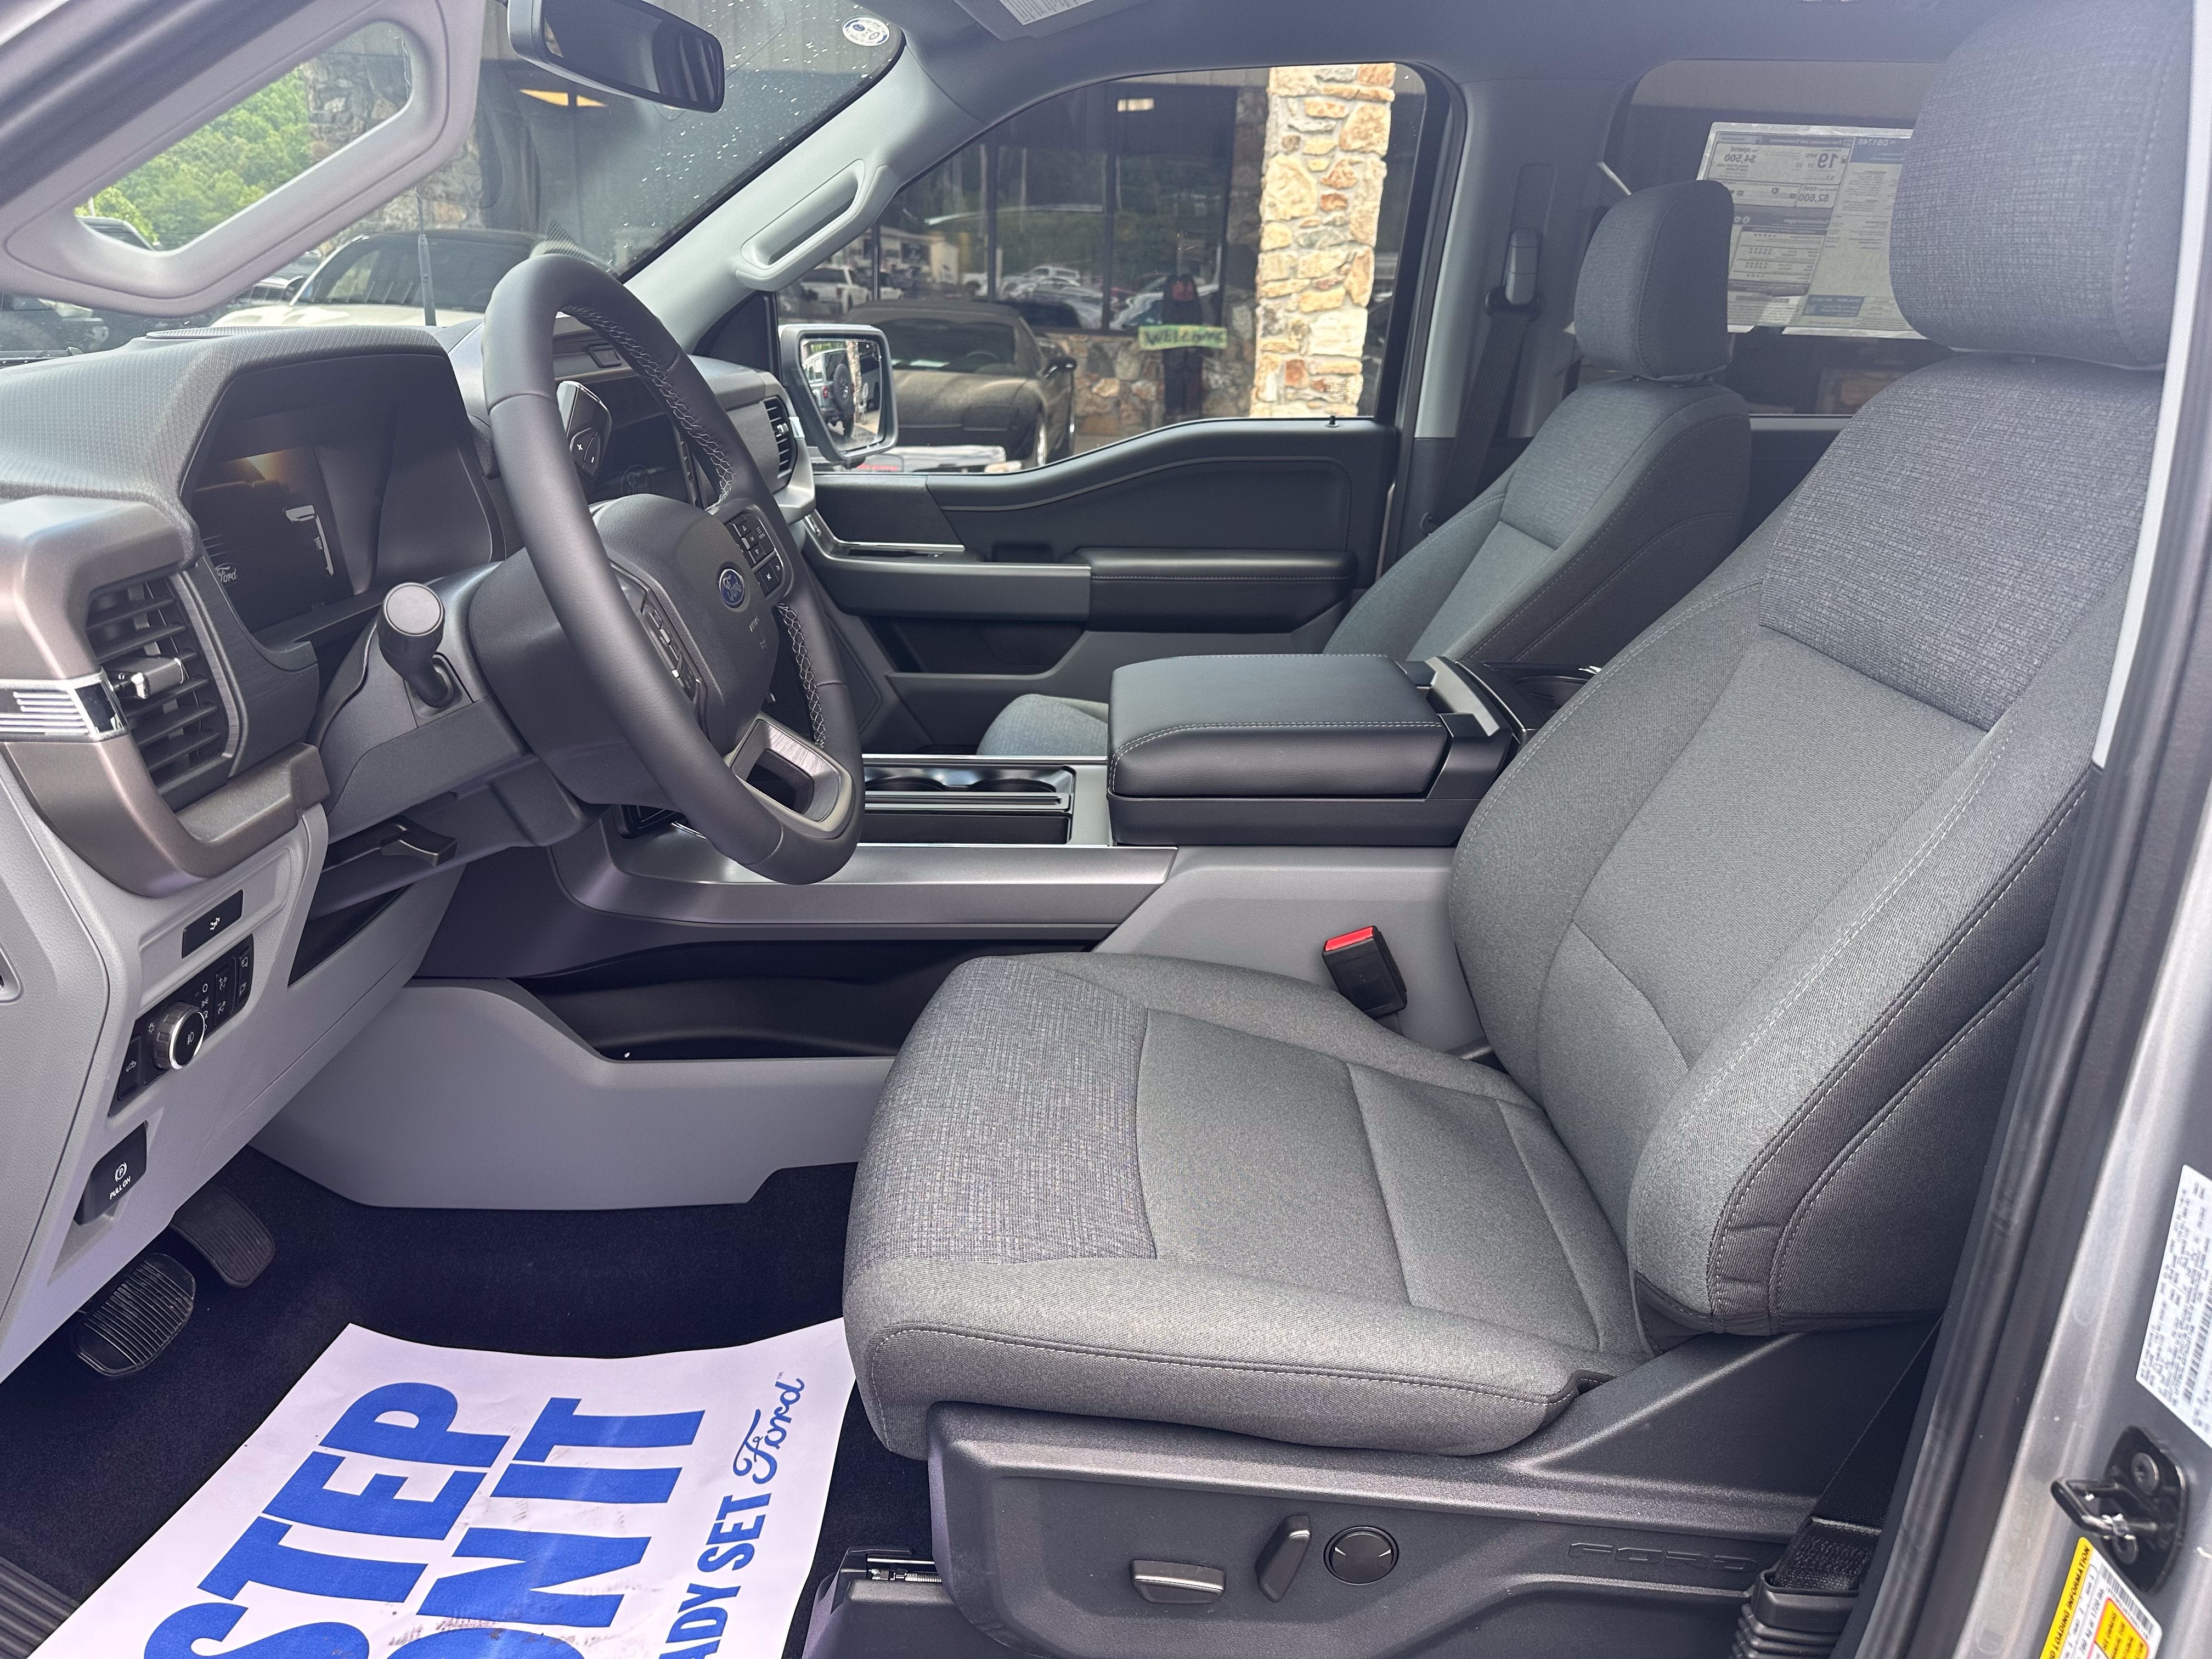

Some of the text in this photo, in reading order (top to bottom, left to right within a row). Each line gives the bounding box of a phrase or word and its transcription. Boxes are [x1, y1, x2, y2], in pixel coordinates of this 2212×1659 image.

[215, 566, 238, 583] Ford
[723, 574, 742, 602] Ford
[110, 1176, 131, 1200] PULL ON
[489, 1397, 706, 1504] IT
[733, 1378, 805, 1484] Ford
[697, 1493, 772, 1572] SET
[1568, 1542, 1757, 1572] FORD
[2054, 1544, 2090, 1651] LOADING INFORMATION
